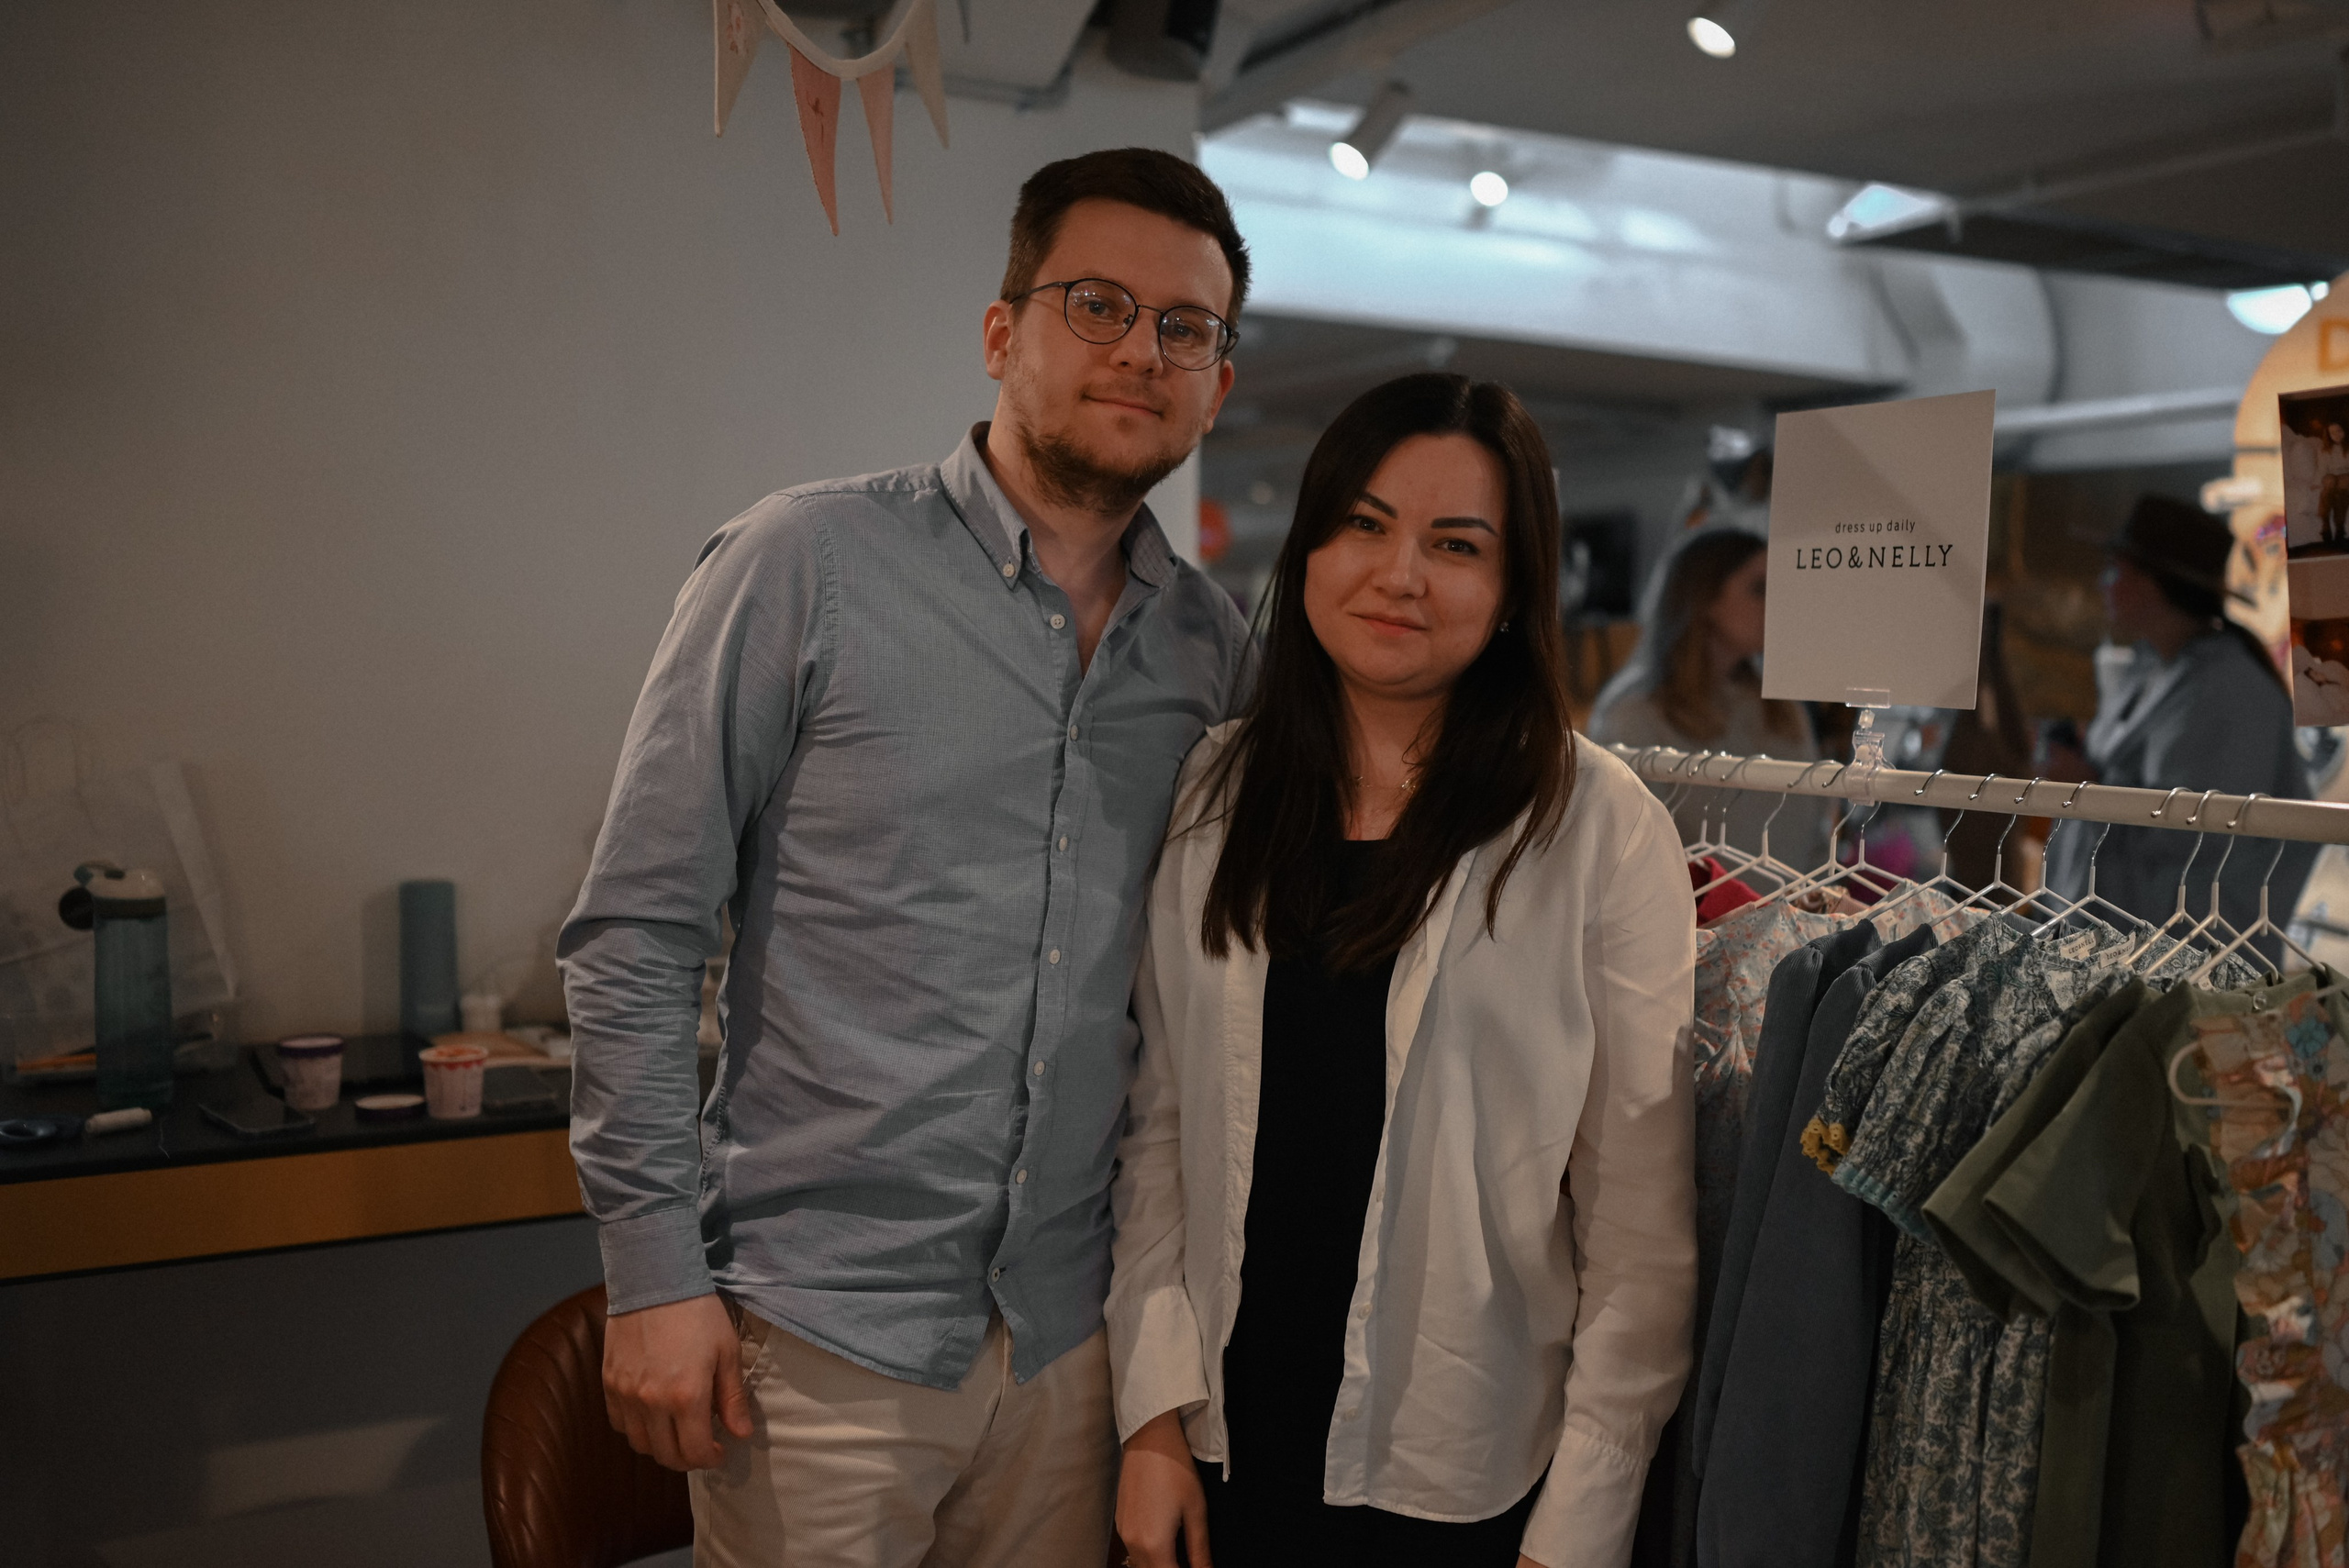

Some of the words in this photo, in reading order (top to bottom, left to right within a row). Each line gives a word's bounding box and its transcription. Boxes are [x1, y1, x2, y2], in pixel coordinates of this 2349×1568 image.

[1835, 521, 1865, 534] dress
[1869, 522, 1883, 535] up
[1887, 518, 1916, 534] daily
[1796, 544, 1954, 570] LEO&NELLY
[2068, 938, 2095, 954] LEO&NELL
